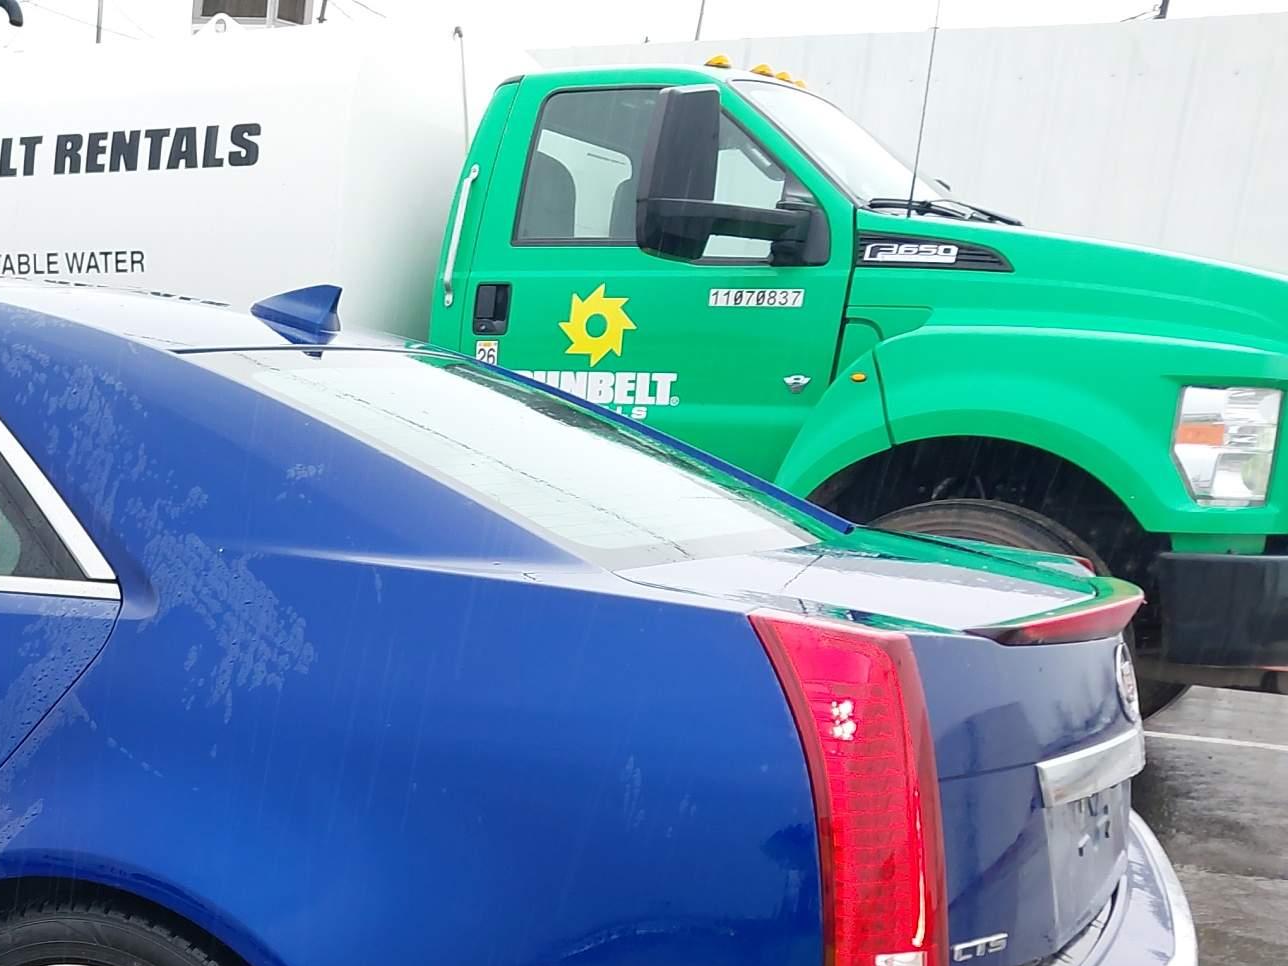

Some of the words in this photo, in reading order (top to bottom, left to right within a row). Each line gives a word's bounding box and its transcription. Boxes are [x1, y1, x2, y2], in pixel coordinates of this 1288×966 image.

[53, 123, 262, 175] RENTALS
[65, 251, 145, 274] WATER
[711, 290, 802, 306] 11070837
[477, 347, 496, 365] 26
[953, 932, 1009, 962] CTS
